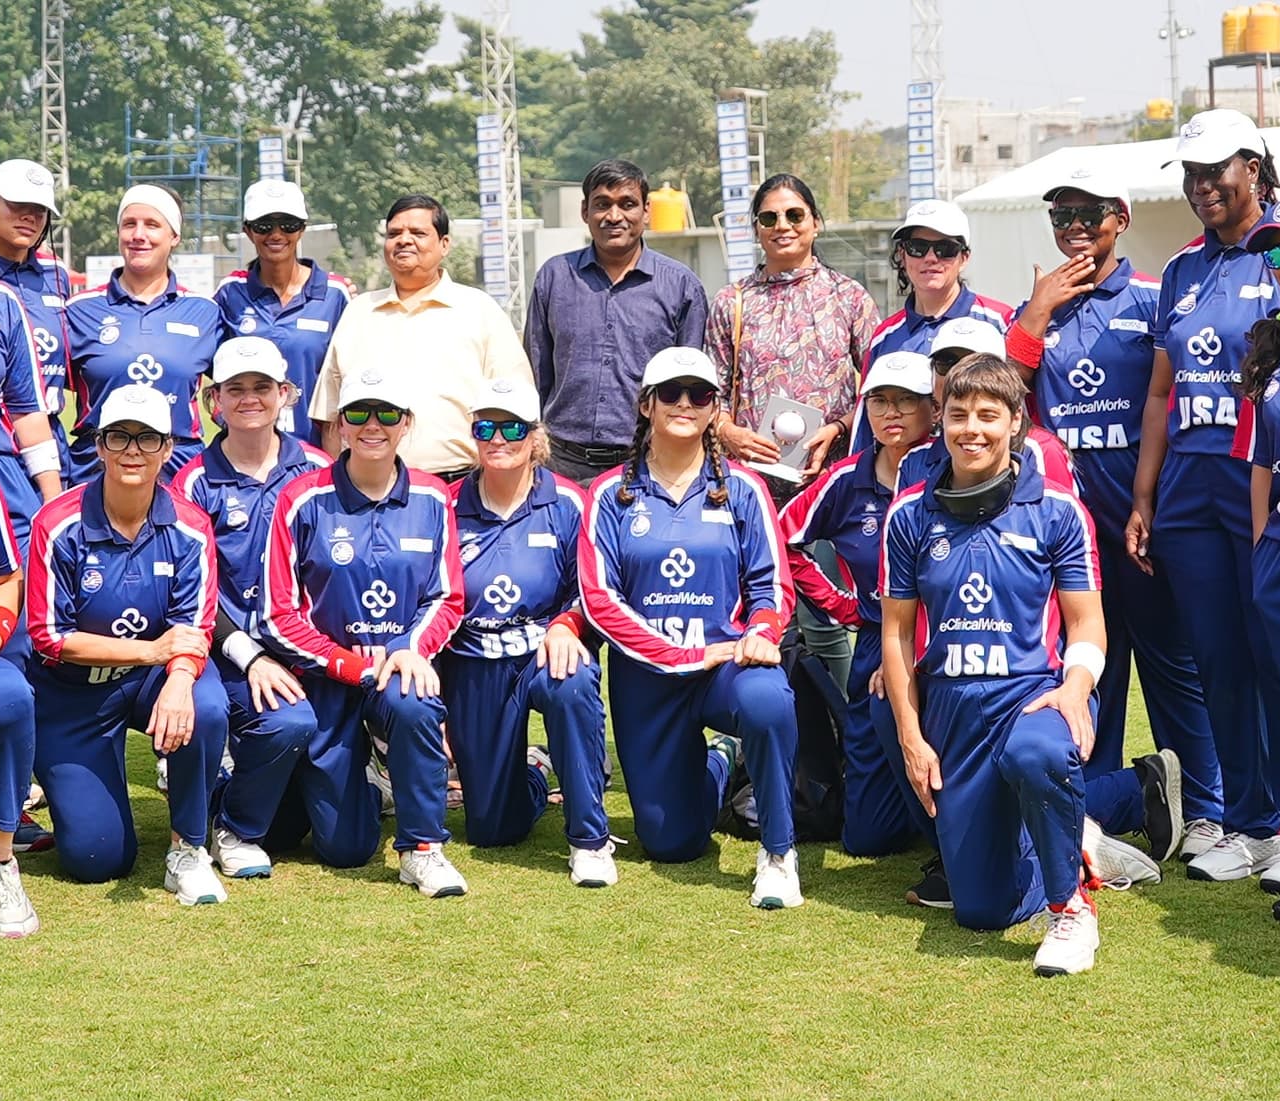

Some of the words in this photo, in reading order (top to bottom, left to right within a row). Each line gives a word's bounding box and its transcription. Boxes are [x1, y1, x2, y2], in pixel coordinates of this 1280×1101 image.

[1049, 397, 1131, 417] eClinicalWorks
[1178, 395, 1239, 431] USA
[345, 620, 405, 635] eClinicalWor
[939, 617, 1014, 633] eClinicalWorks
[480, 623, 548, 660] USA
[944, 643, 1010, 678] USA
